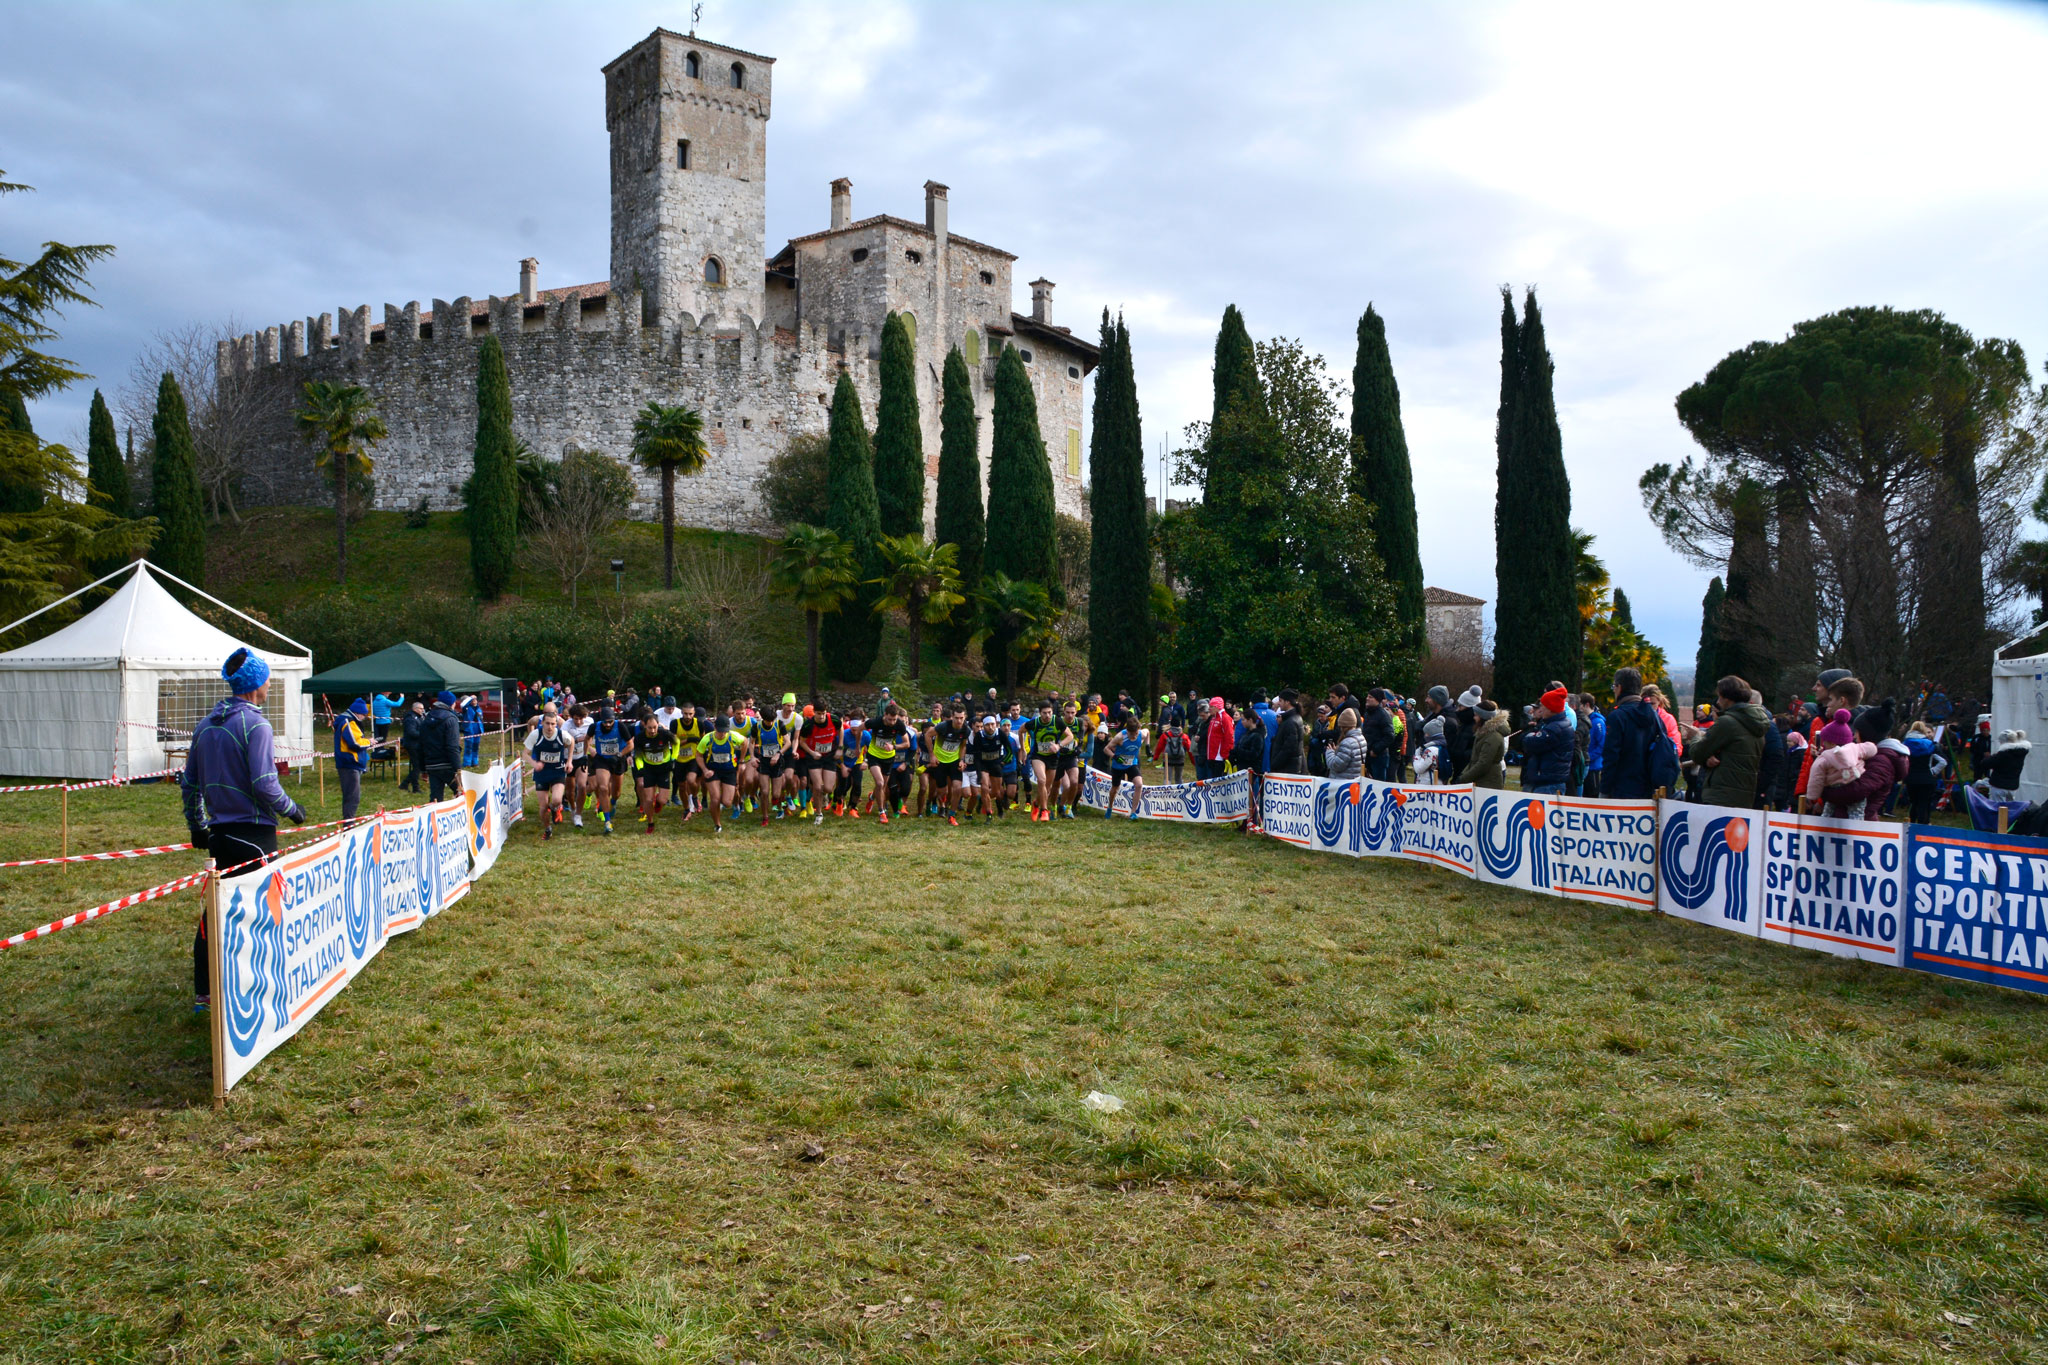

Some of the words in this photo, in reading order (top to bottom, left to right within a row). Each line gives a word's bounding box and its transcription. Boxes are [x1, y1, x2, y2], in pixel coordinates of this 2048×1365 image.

[1264, 781, 1312, 799] CENTRO
[1150, 801, 1183, 812] ITALIANO
[1264, 800, 1311, 817] SPORTIVO
[1549, 809, 1655, 835] CENTRO
[437, 809, 467, 838] CENTRO
[1264, 818, 1310, 837] ITALIANO
[1404, 807, 1473, 838] SPORTIVO
[1403, 829, 1473, 862] ITALIANO
[1551, 835, 1655, 864] SPORTIVO
[1768, 830, 1899, 872] CENTRO
[284, 855, 341, 911] CENTRO
[1552, 862, 1655, 894] ITALIANO
[1767, 862, 1898, 908] SPORTIVO
[286, 893, 343, 957] SPORTIVO
[1766, 892, 1897, 942] ITALIANO
[288, 934, 345, 1004] ITALIANO
